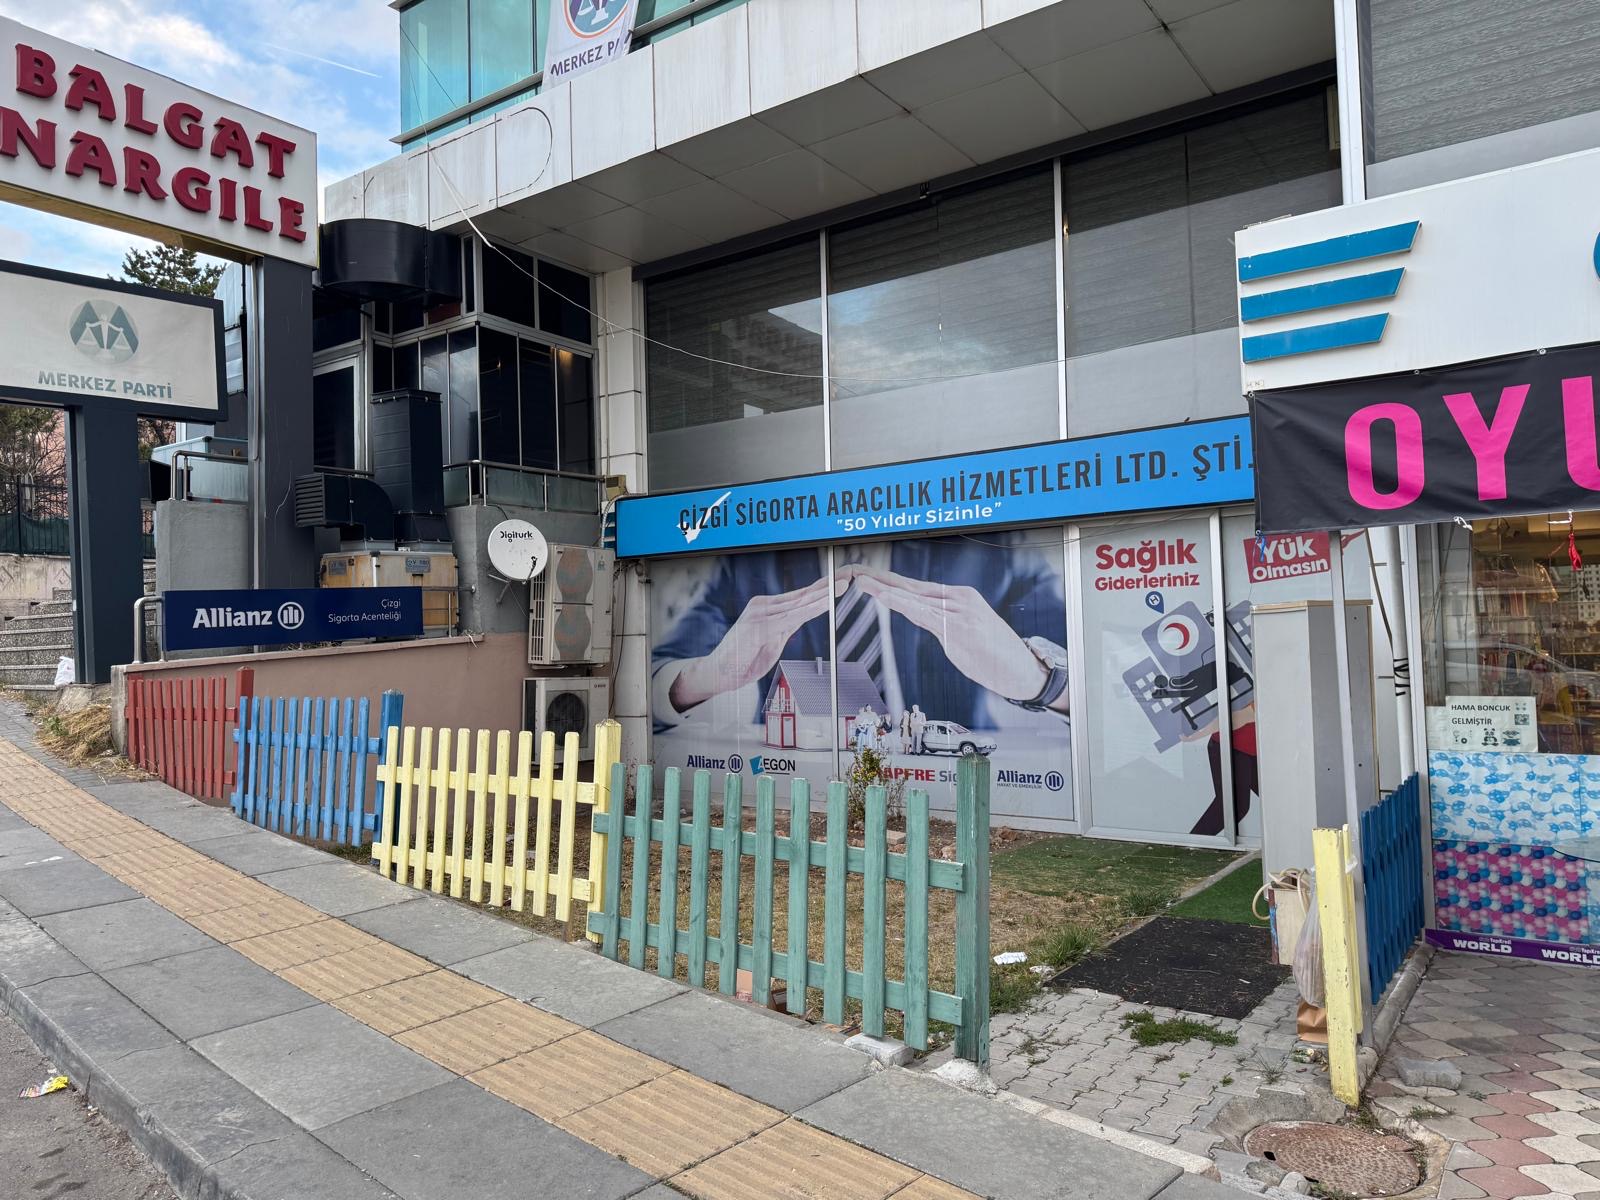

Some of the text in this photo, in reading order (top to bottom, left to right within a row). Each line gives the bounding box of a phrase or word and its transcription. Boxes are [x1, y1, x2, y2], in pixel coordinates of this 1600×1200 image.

[550, 45, 604, 77] MERKEZ
[15, 43, 297, 179] BALGAT
[0, 106, 307, 243] NARGILE
[38, 370, 172, 399] MERKEZ PARTİ
[679, 434, 1256, 536] ÇİZGİ SİGORTA ARACILIK HİZMETLERİ LTD. ŞTİ.
[871, 513, 921, 529] Yıldır
[500, 530, 533, 543] Digiturk
[1095, 538, 1198, 573] Sağlık
[1257, 535, 1317, 564] Yük
[1252, 558, 1329, 581] Olmasın
[1094, 572, 1200, 592] Giderleriniz
[381, 598, 401, 609] Çizgi
[192, 606, 273, 629] Allianz
[328, 611, 402, 625] Sigorta Acenteliği
[1451, 704, 1511, 712] HAMA BONCUK
[1451, 716, 1493, 726] GELMİŞTİR
[687, 755, 725, 770] Allianz
[757, 757, 796, 772] AEGON
[875, 767, 936, 782] APFRE
[997, 769, 1043, 785] Allianz
[1453, 939, 1512, 954] WORLD
